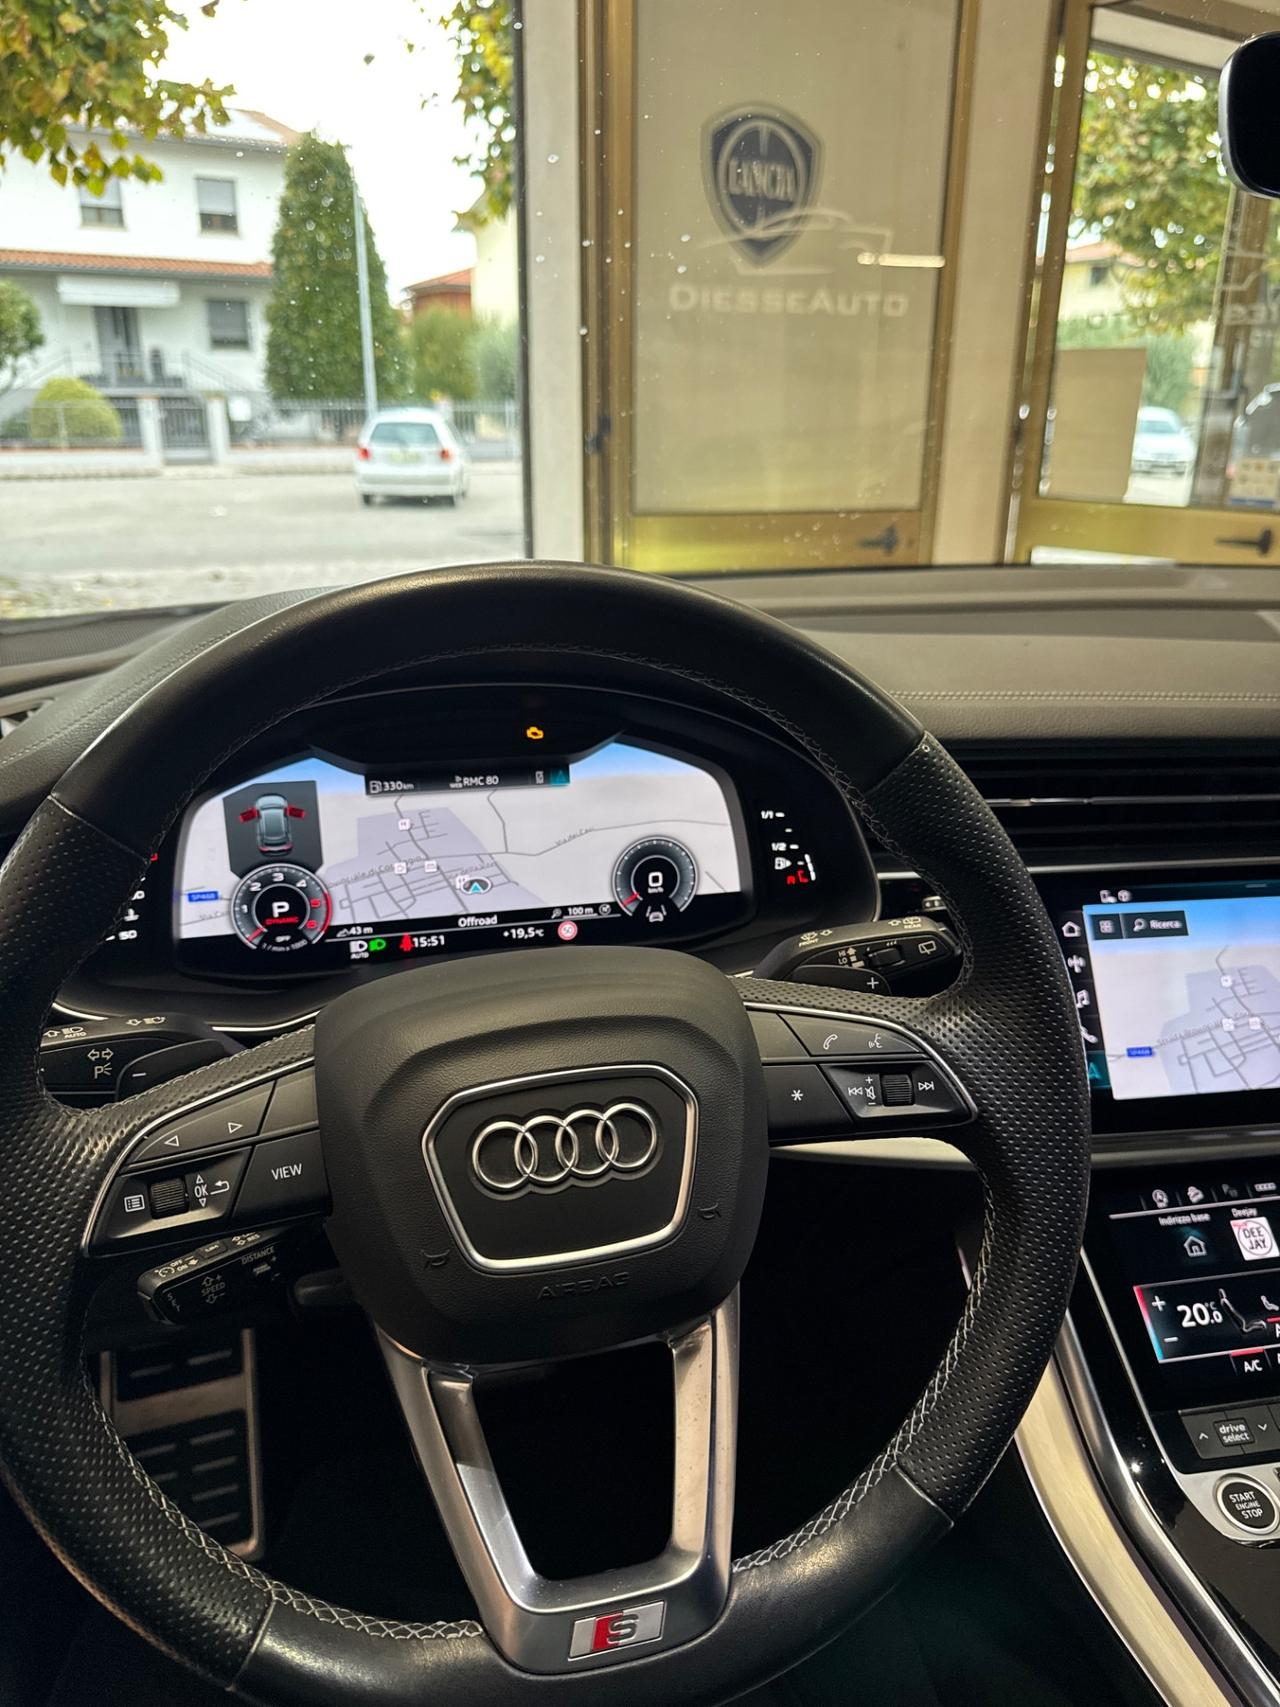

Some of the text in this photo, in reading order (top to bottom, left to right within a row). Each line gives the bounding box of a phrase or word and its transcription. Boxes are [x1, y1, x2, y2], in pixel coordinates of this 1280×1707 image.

[463, 775, 499, 787] RMC 80
[272, 872, 285, 882] 3
[249, 882, 262, 892] 2
[272, 901, 290, 918] P
[567, 906, 584, 916] 100
[457, 914, 498, 928] Offroad
[1149, 918, 1183, 930] Ricerca
[349, 926, 374, 936] 43 m
[412, 935, 446, 949] 15:51
[350, 952, 370, 960] AUTO
[64, 1031, 88, 1040] AUTO
[271, 1163, 302, 1181] VIEW
[194, 1184, 209, 1198] OK
[1191, 1212, 1211, 1223] base
[1242, 1227, 1264, 1239] DEE
[1248, 1239, 1267, 1250] JAY
[241, 1245, 275, 1265] DISTANCE
[201, 1281, 226, 1297] SPEED
[1243, 1359, 1263, 1373] A/C
[1218, 1422, 1247, 1435] drive
[1222, 1431, 1250, 1444] select
[1228, 1491, 1256, 1504] START
[1234, 1501, 1261, 1511] ENGINE
[1241, 1508, 1263, 1520] STOP
